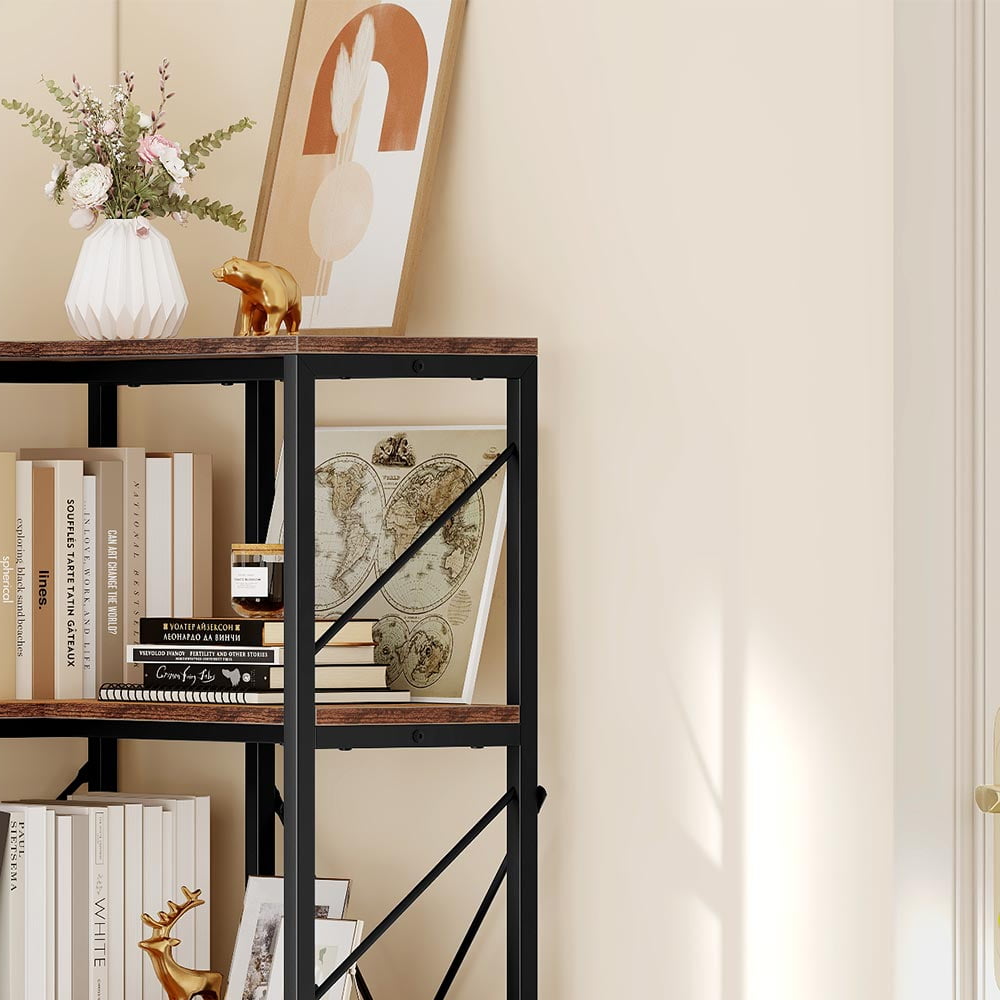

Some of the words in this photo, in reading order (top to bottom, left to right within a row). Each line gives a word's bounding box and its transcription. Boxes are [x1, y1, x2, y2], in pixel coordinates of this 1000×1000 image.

[66, 499, 77, 549] SOUFFLÉS
[107, 529, 117, 545] CAN
[16, 518, 25, 564] exploring
[107, 546, 117, 561] ART
[0, 556, 14, 604] spherical
[16, 567, 26, 593] black
[66, 552, 75, 584] TARTE
[107, 561, 117, 590] CHANGE
[38, 570, 50, 610] lines.
[66, 585, 75, 616] TATIN
[107, 591, 117, 605] THE
[16, 595, 26, 618] sand
[107, 606, 117, 635] WORLD?
[83, 610, 91, 635] AND
[16, 619, 26, 658] beaches
[66, 620, 78, 668] GÂTEAUX
[83, 642, 91, 671] LIFE
[10, 821, 18, 892] SIETSEMA
[93, 897, 107, 968] WHITE
